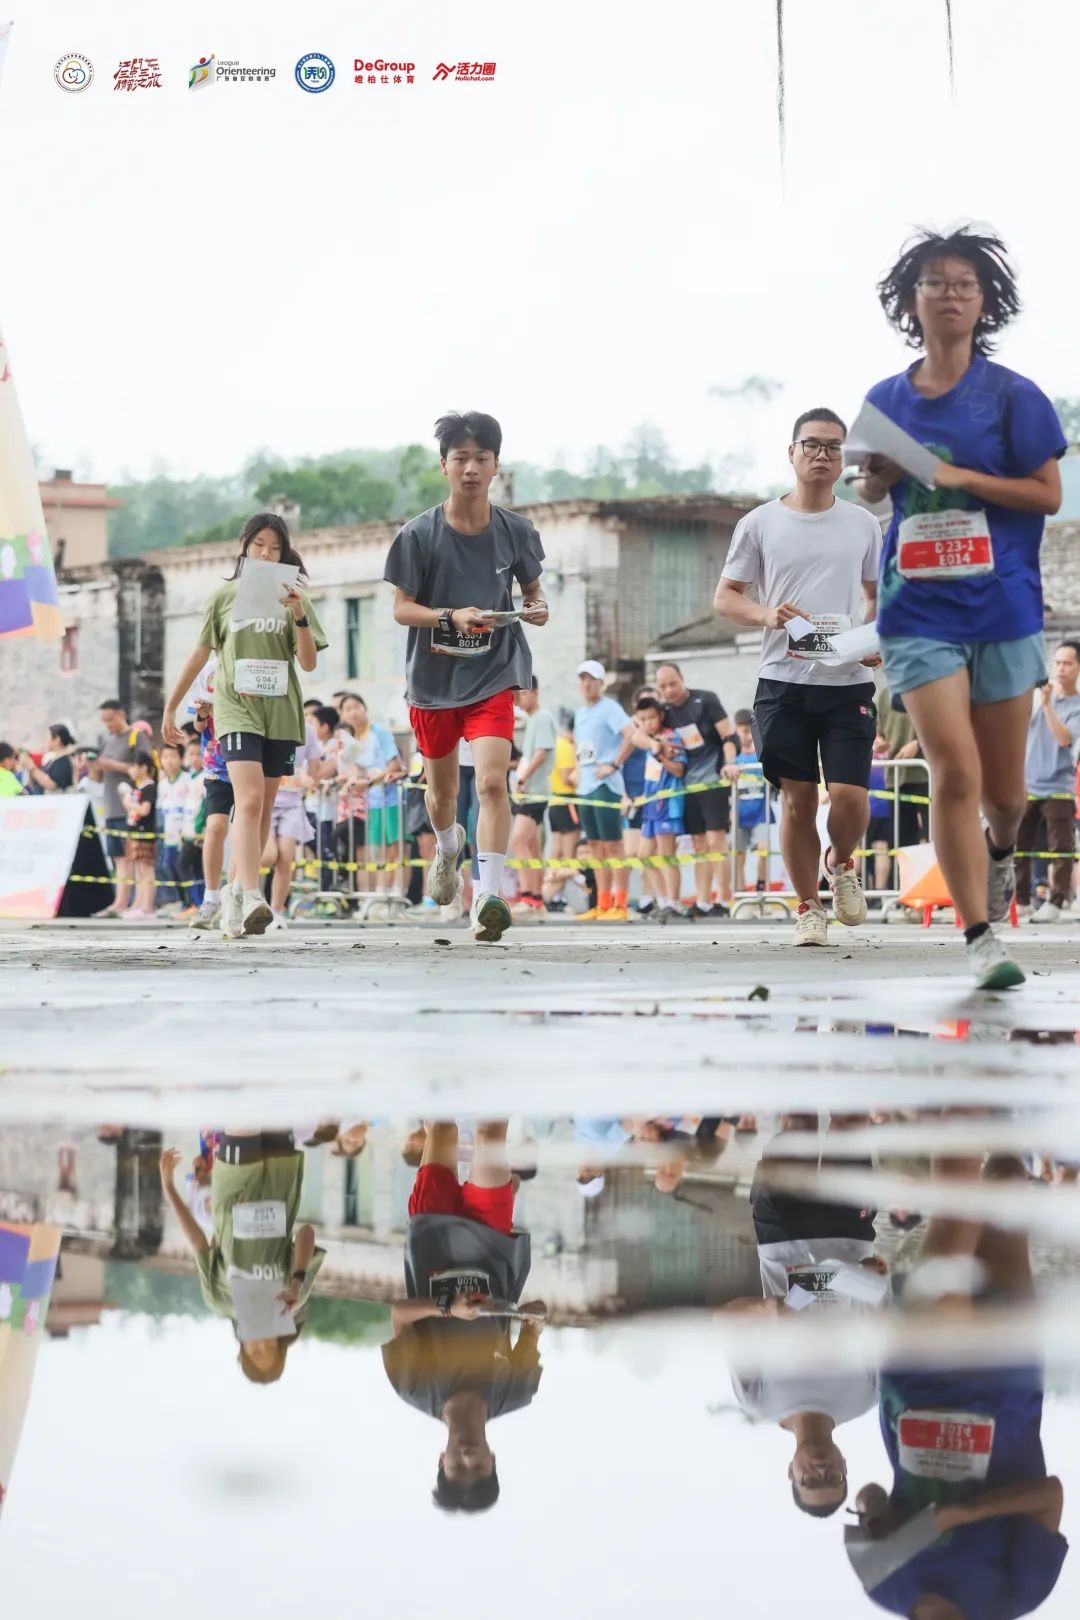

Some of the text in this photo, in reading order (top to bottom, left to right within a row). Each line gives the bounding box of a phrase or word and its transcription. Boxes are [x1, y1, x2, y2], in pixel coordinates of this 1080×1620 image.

[939, 552, 971, 566] E014
[458, 639, 480, 648] B014
[815, 643, 833, 651] A01
